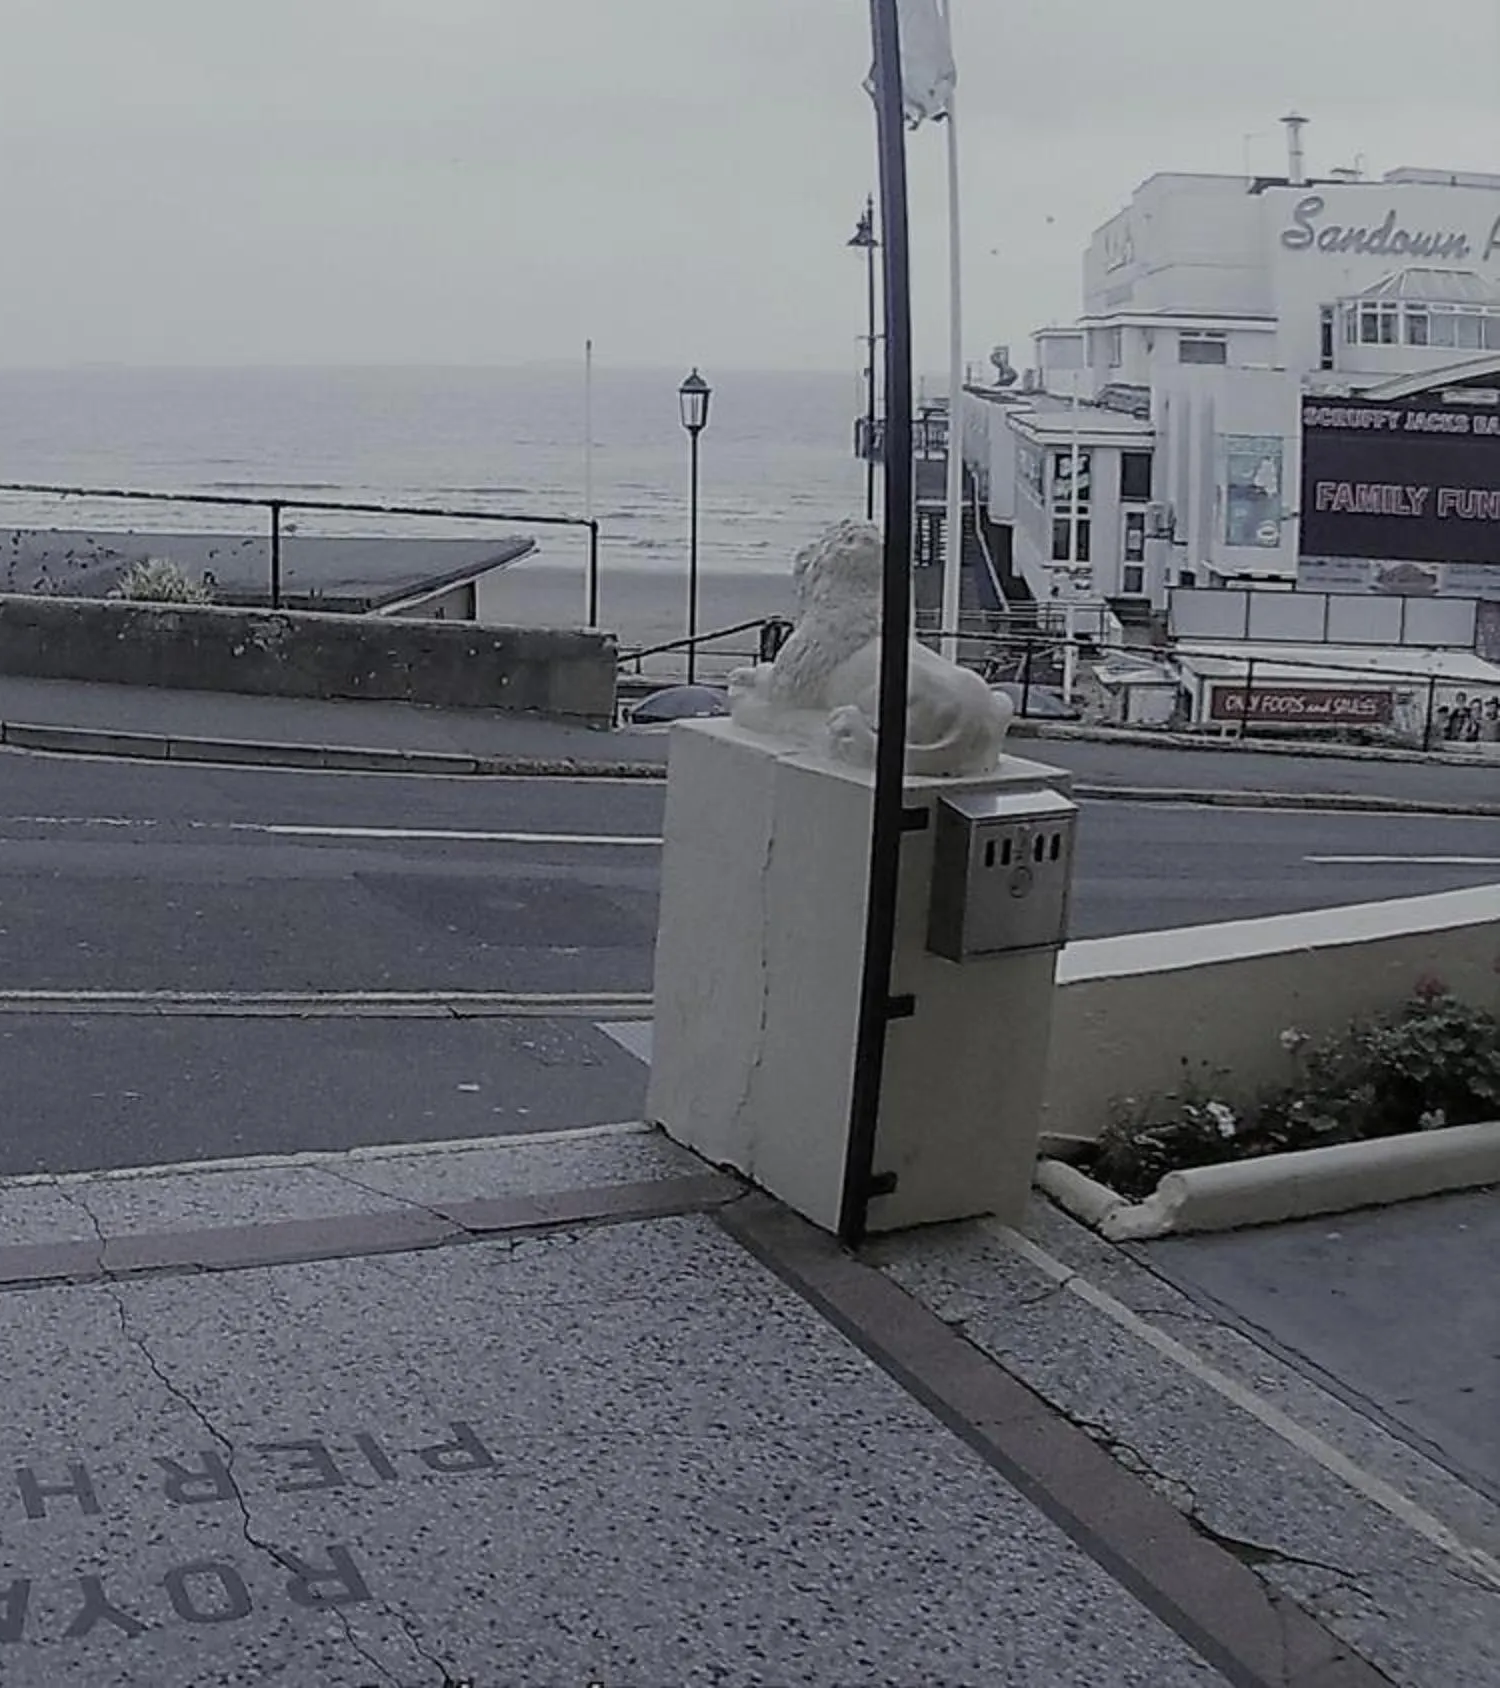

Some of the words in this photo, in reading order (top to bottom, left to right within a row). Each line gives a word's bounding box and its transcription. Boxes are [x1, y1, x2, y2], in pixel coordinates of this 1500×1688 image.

[1281, 196, 1471, 259] Sandown
[1303, 406, 1400, 431] SCRUFFY
[1404, 411, 1470, 434] JACKS
[1315, 481, 1430, 516] FAMILY
[1437, 487, 1500, 519] FUN
[152, 1420, 497, 1504] PIER
